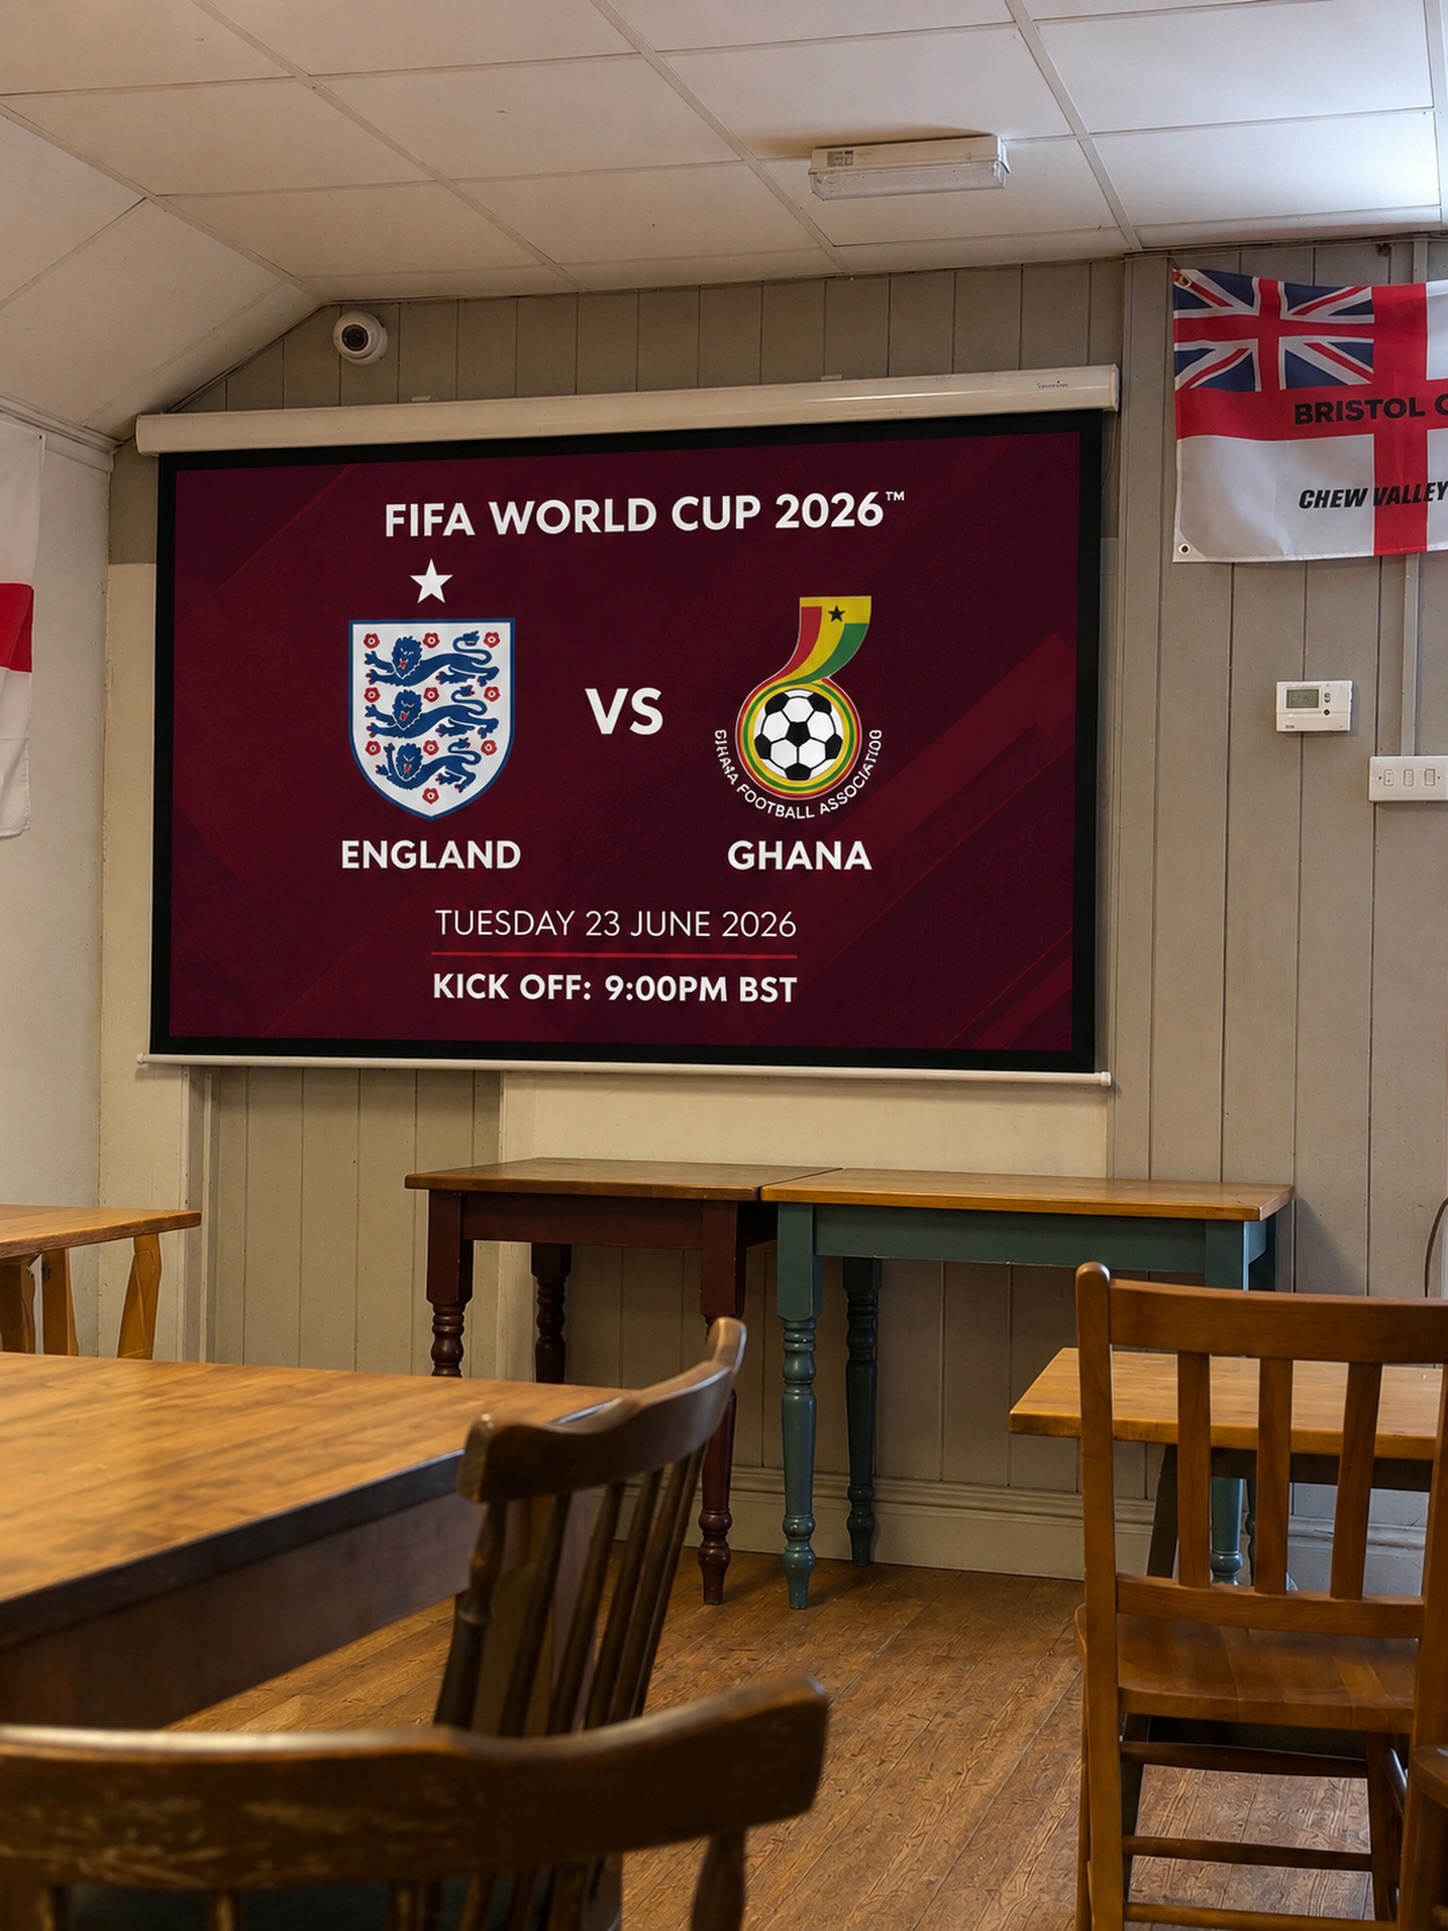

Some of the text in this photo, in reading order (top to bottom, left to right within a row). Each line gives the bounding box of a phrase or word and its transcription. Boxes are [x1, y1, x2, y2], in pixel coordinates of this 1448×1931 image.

[1294, 396, 1426, 425] BRISTOL
[1298, 480, 1448, 509] CHEW VALLEY
[385, 502, 476, 537] FIFA
[488, 497, 657, 535] WORLD
[671, 494, 761, 532] CUP
[584, 686, 664, 736] VS
[736, 783, 815, 820] FOOTBALL
[341, 839, 521, 870] ENGLAND
[727, 839, 873, 871] GHANA
[434, 908, 797, 938] TUESDAY 23 JUNE 2026
[433, 972, 798, 1003] KICK OFF: 9:00PM BST
